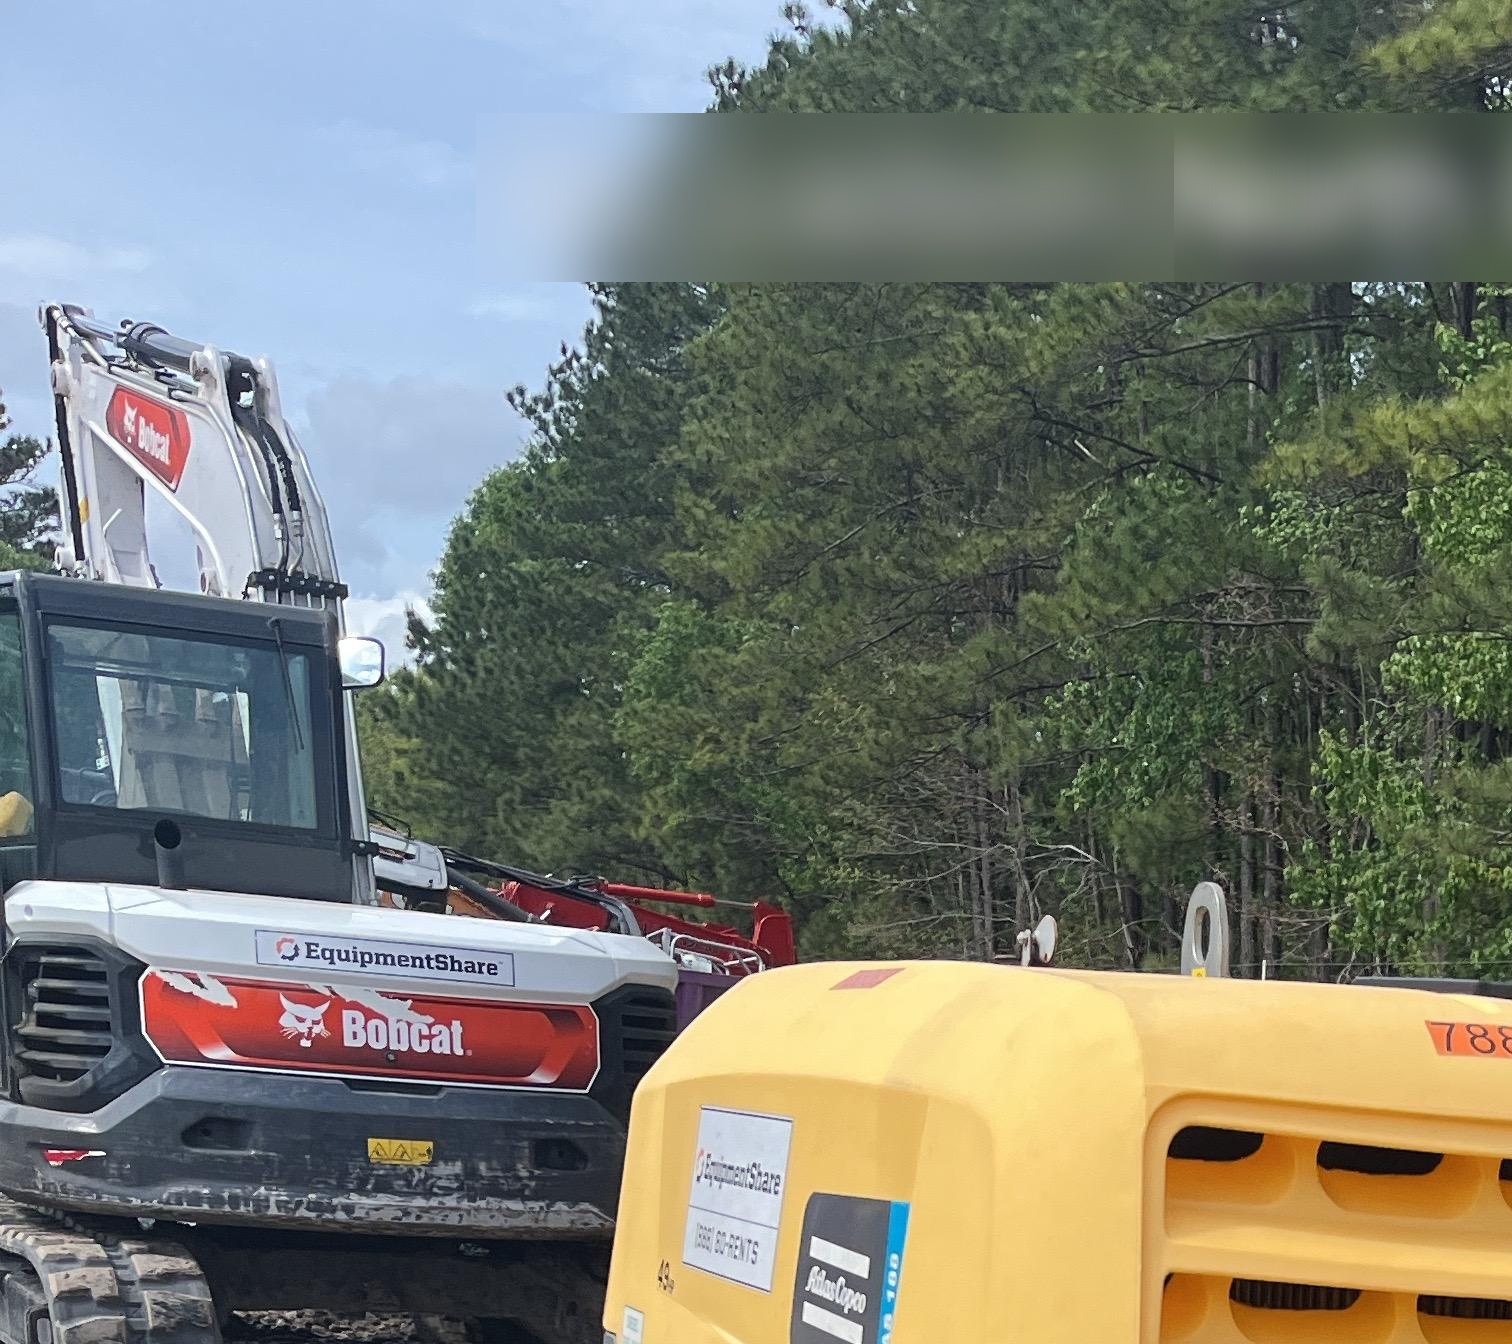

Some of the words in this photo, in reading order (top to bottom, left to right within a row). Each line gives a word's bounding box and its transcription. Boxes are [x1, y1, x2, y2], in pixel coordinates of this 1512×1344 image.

[138, 415, 170, 466] Bobcat
[305, 941, 498, 976] EquipmentShare
[342, 1009, 464, 1056] Bobcat
[704, 1152, 781, 1195] EquipmentShare
